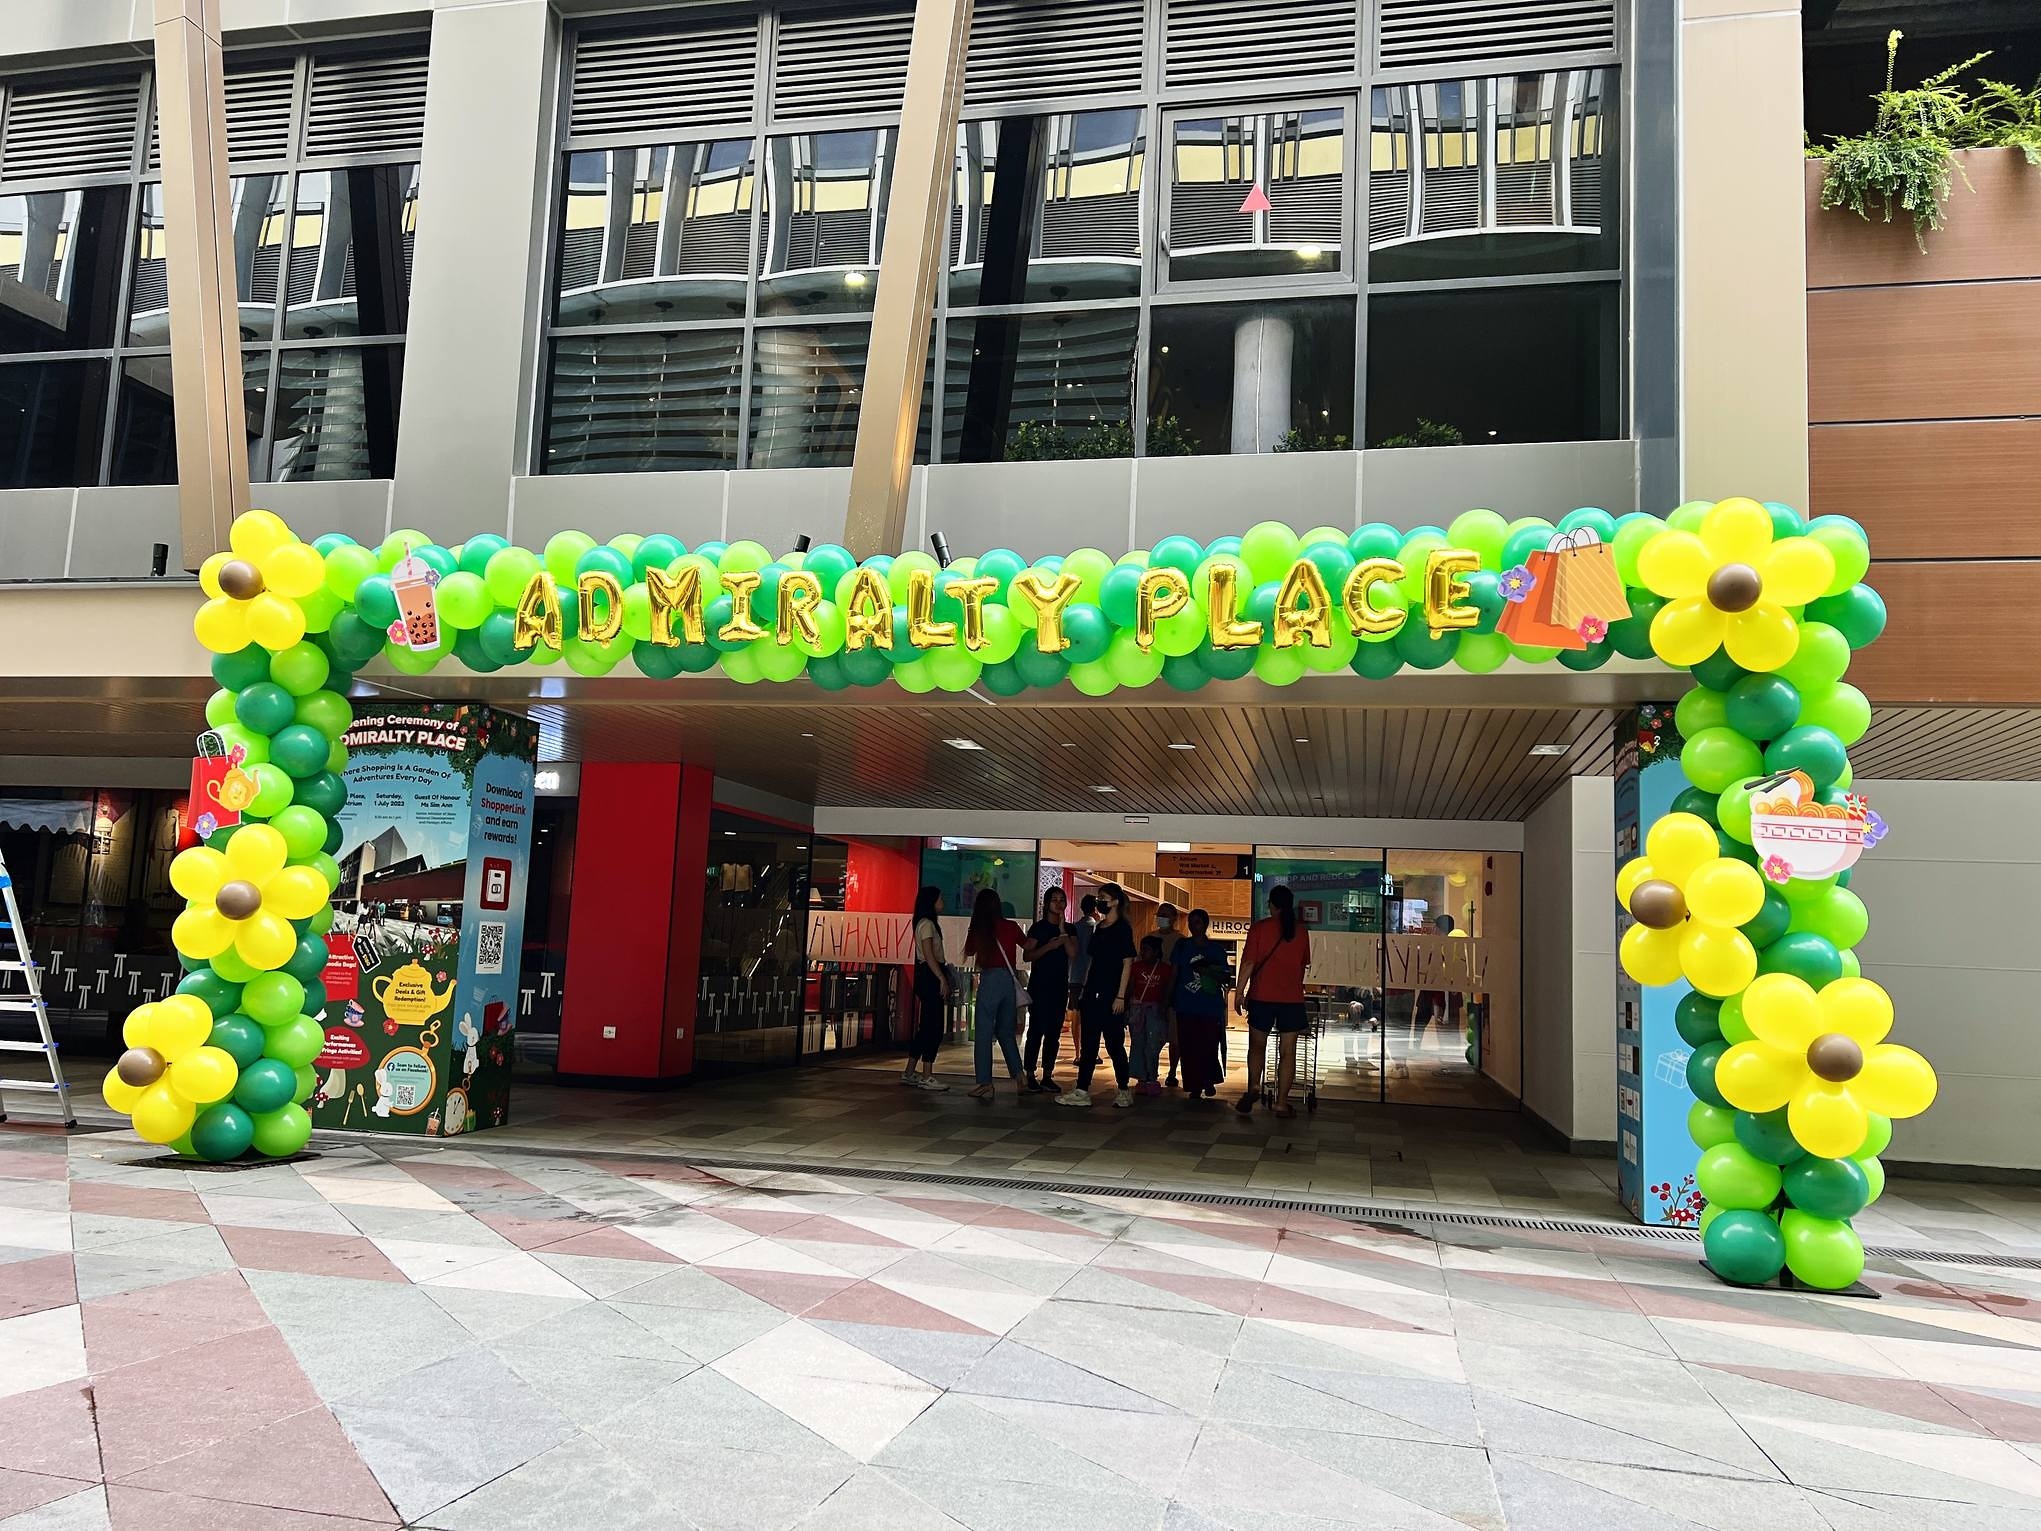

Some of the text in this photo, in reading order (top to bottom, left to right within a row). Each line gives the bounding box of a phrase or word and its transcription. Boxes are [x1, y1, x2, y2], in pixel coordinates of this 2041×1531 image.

[514, 548, 1482, 654] ADMIRALTY PLACE
[387, 714, 445, 730] Ceremony
[446, 721, 460, 731] of
[339, 729, 467, 751] DMIRALTY PLACE
[340, 767, 361, 777] here
[362, 763, 396, 773] Shopping
[413, 765, 440, 777] Garden
[441, 771, 452, 780] Of
[353, 773, 433, 786] Adventures Every Day
[486, 783, 523, 799] Download
[481, 797, 527, 816] ShopperLink
[485, 815, 519, 830] and earn
[484, 832, 518, 845] rewards!
[1243, 866, 1249, 876] 1
